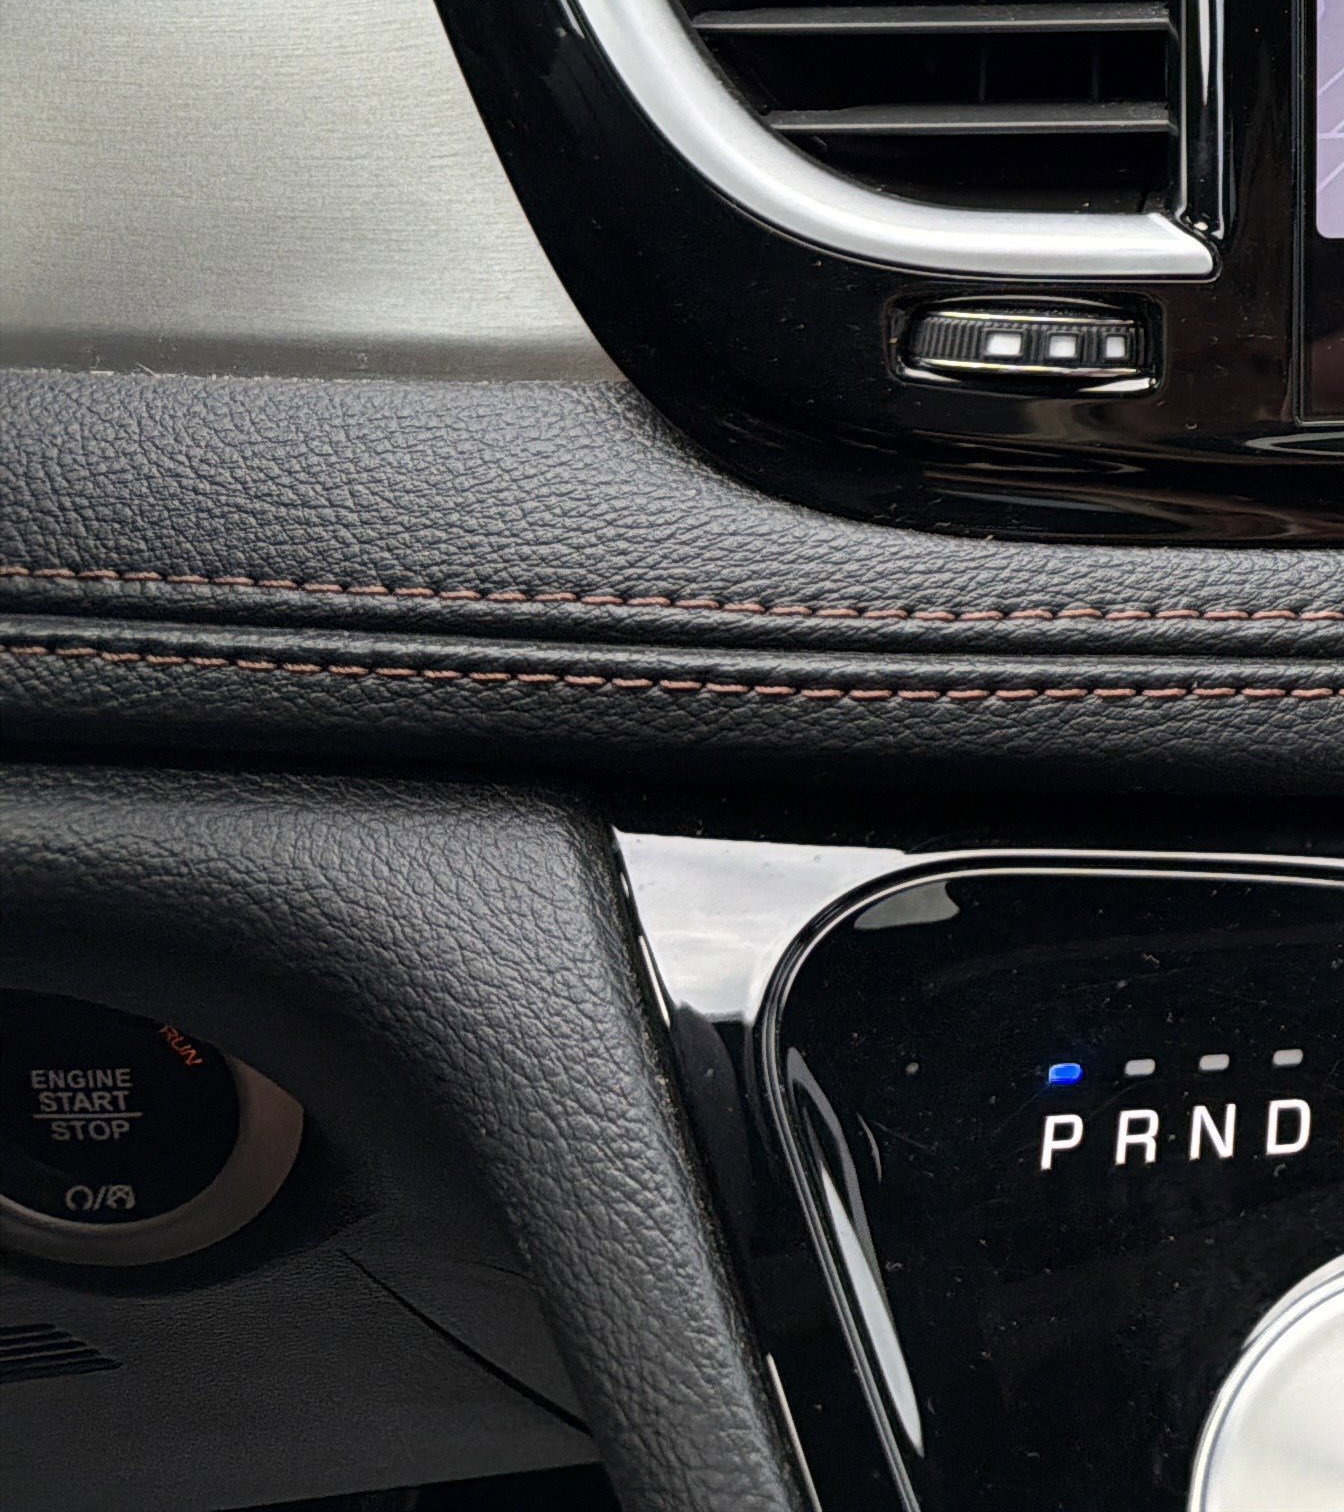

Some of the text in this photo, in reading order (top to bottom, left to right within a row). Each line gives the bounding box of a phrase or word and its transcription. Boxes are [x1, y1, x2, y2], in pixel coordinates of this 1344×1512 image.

[159, 1023, 203, 1066] RUN
[30, 1068, 133, 1088] ENGINE
[38, 1091, 129, 1112] START
[51, 1120, 130, 1140] STOP
[1041, 1114, 1084, 1170] P
[1115, 1109, 1159, 1165] R
[1189, 1104, 1236, 1160] N
[1266, 1098, 1311, 1156] D
